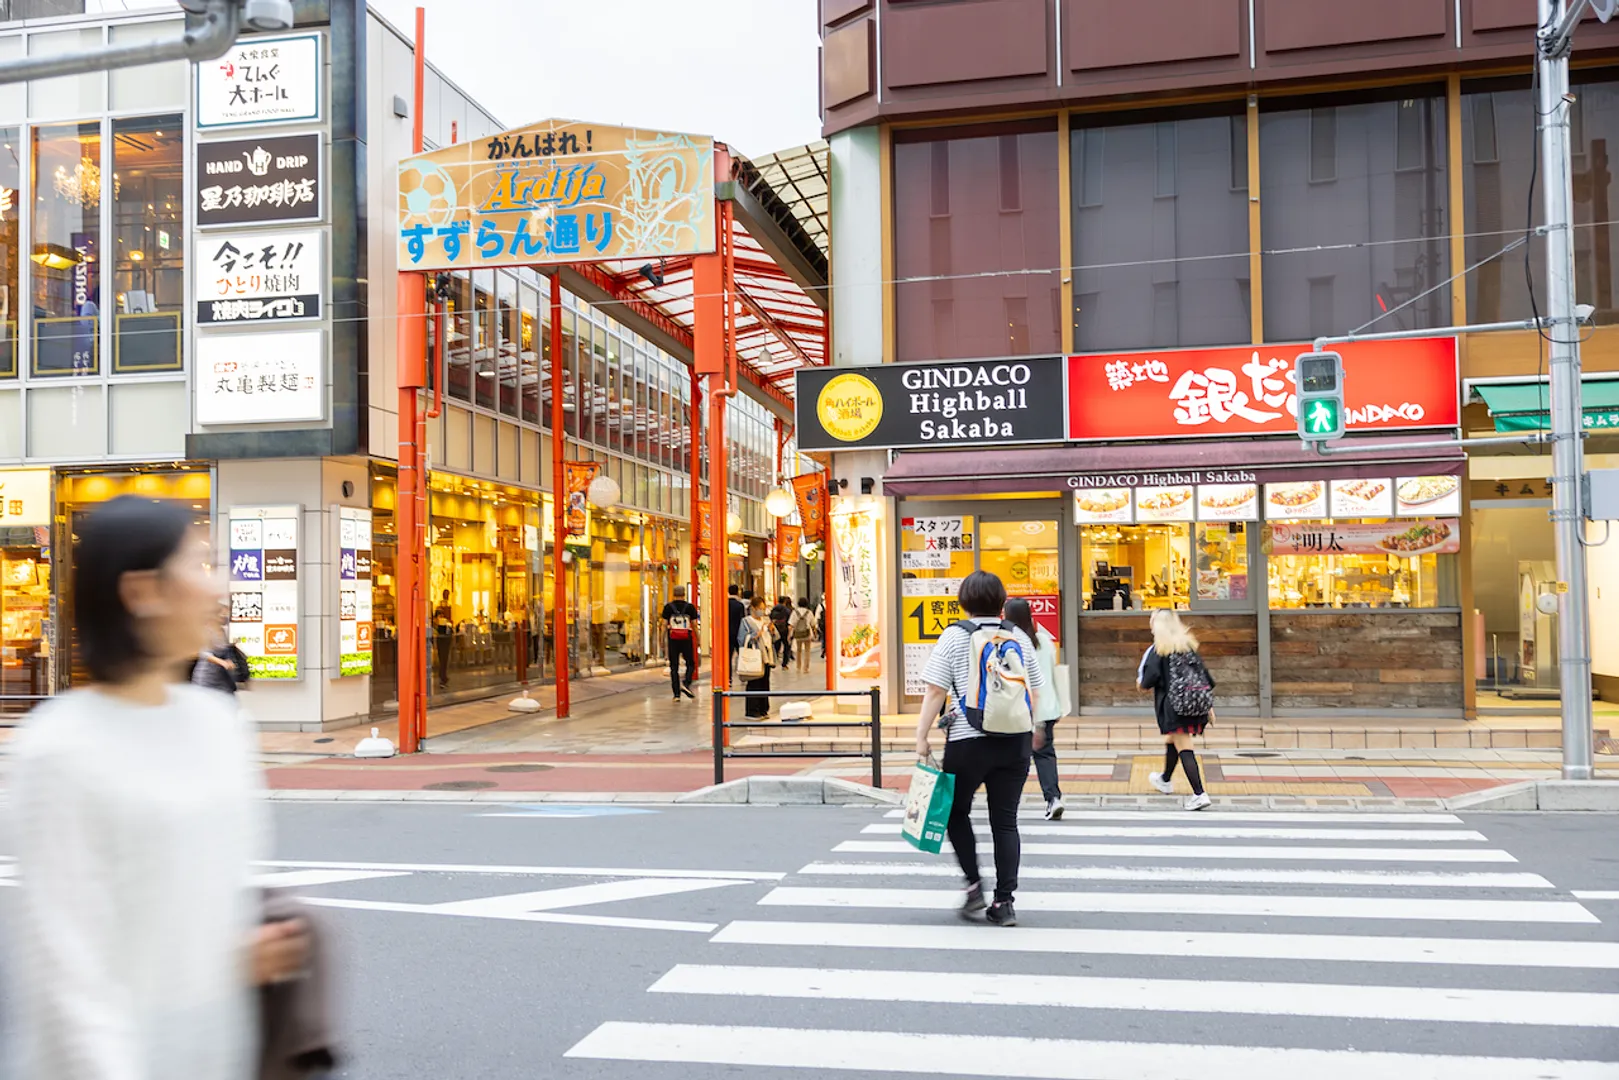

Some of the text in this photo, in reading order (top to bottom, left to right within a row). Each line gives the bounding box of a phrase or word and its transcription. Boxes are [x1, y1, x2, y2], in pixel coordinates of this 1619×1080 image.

[239, 63, 280, 82] てんぐ
[229, 84, 289, 106] 大ホール
[206, 155, 308, 174] HAND DRIP
[200, 178, 316, 211] 星乃珈琲店
[475, 161, 607, 214] Ardija
[401, 212, 613, 264] すずらん通り
[216, 273, 300, 295] ひとり焼肉
[214, 373, 300, 395] 丸亀製麺
[901, 364, 1032, 390] GINDACO
[1105, 359, 1169, 391] 築地
[837, 407, 862, 420] 酒場
[909, 388, 1028, 419] Highball
[1344, 402, 1425, 425] INDACO
[919, 417, 1015, 441] Sakaba
[1067, 470, 1257, 488] GINDACO Highball Sakaba
[916, 519, 962, 533] スタッフ
[925, 536, 962, 551] 大募集
[1302, 532, 1345, 552] 明太
[930, 600, 960, 615] 客席
[1026, 599, 1056, 613] ウト
